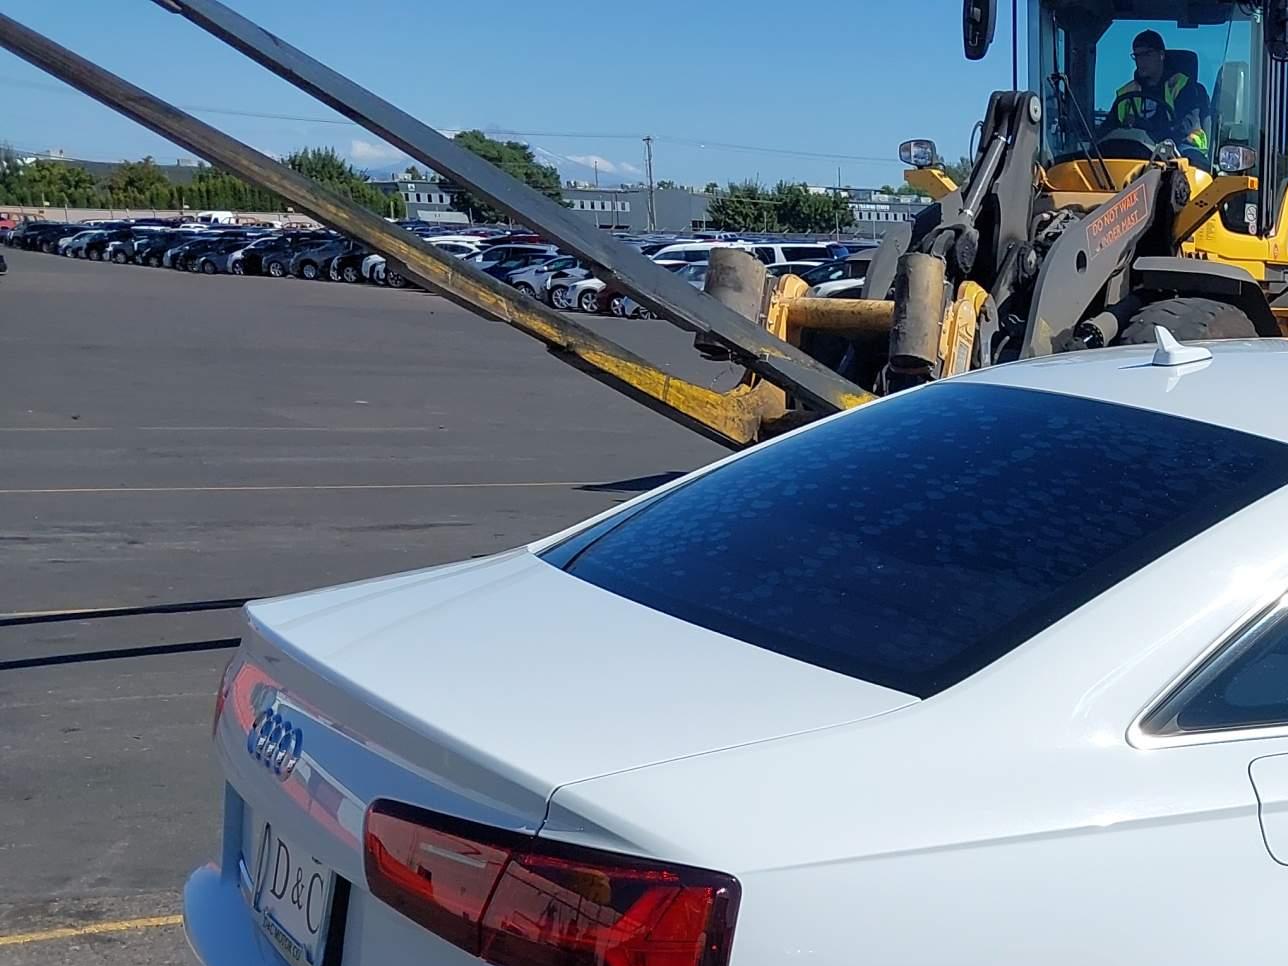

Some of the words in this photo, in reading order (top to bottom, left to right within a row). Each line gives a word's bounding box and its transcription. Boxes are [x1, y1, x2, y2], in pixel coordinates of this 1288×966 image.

[1092, 219, 1104, 236] DO
[1104, 206, 1119, 226] NOT
[1119, 191, 1139, 212] WALK
